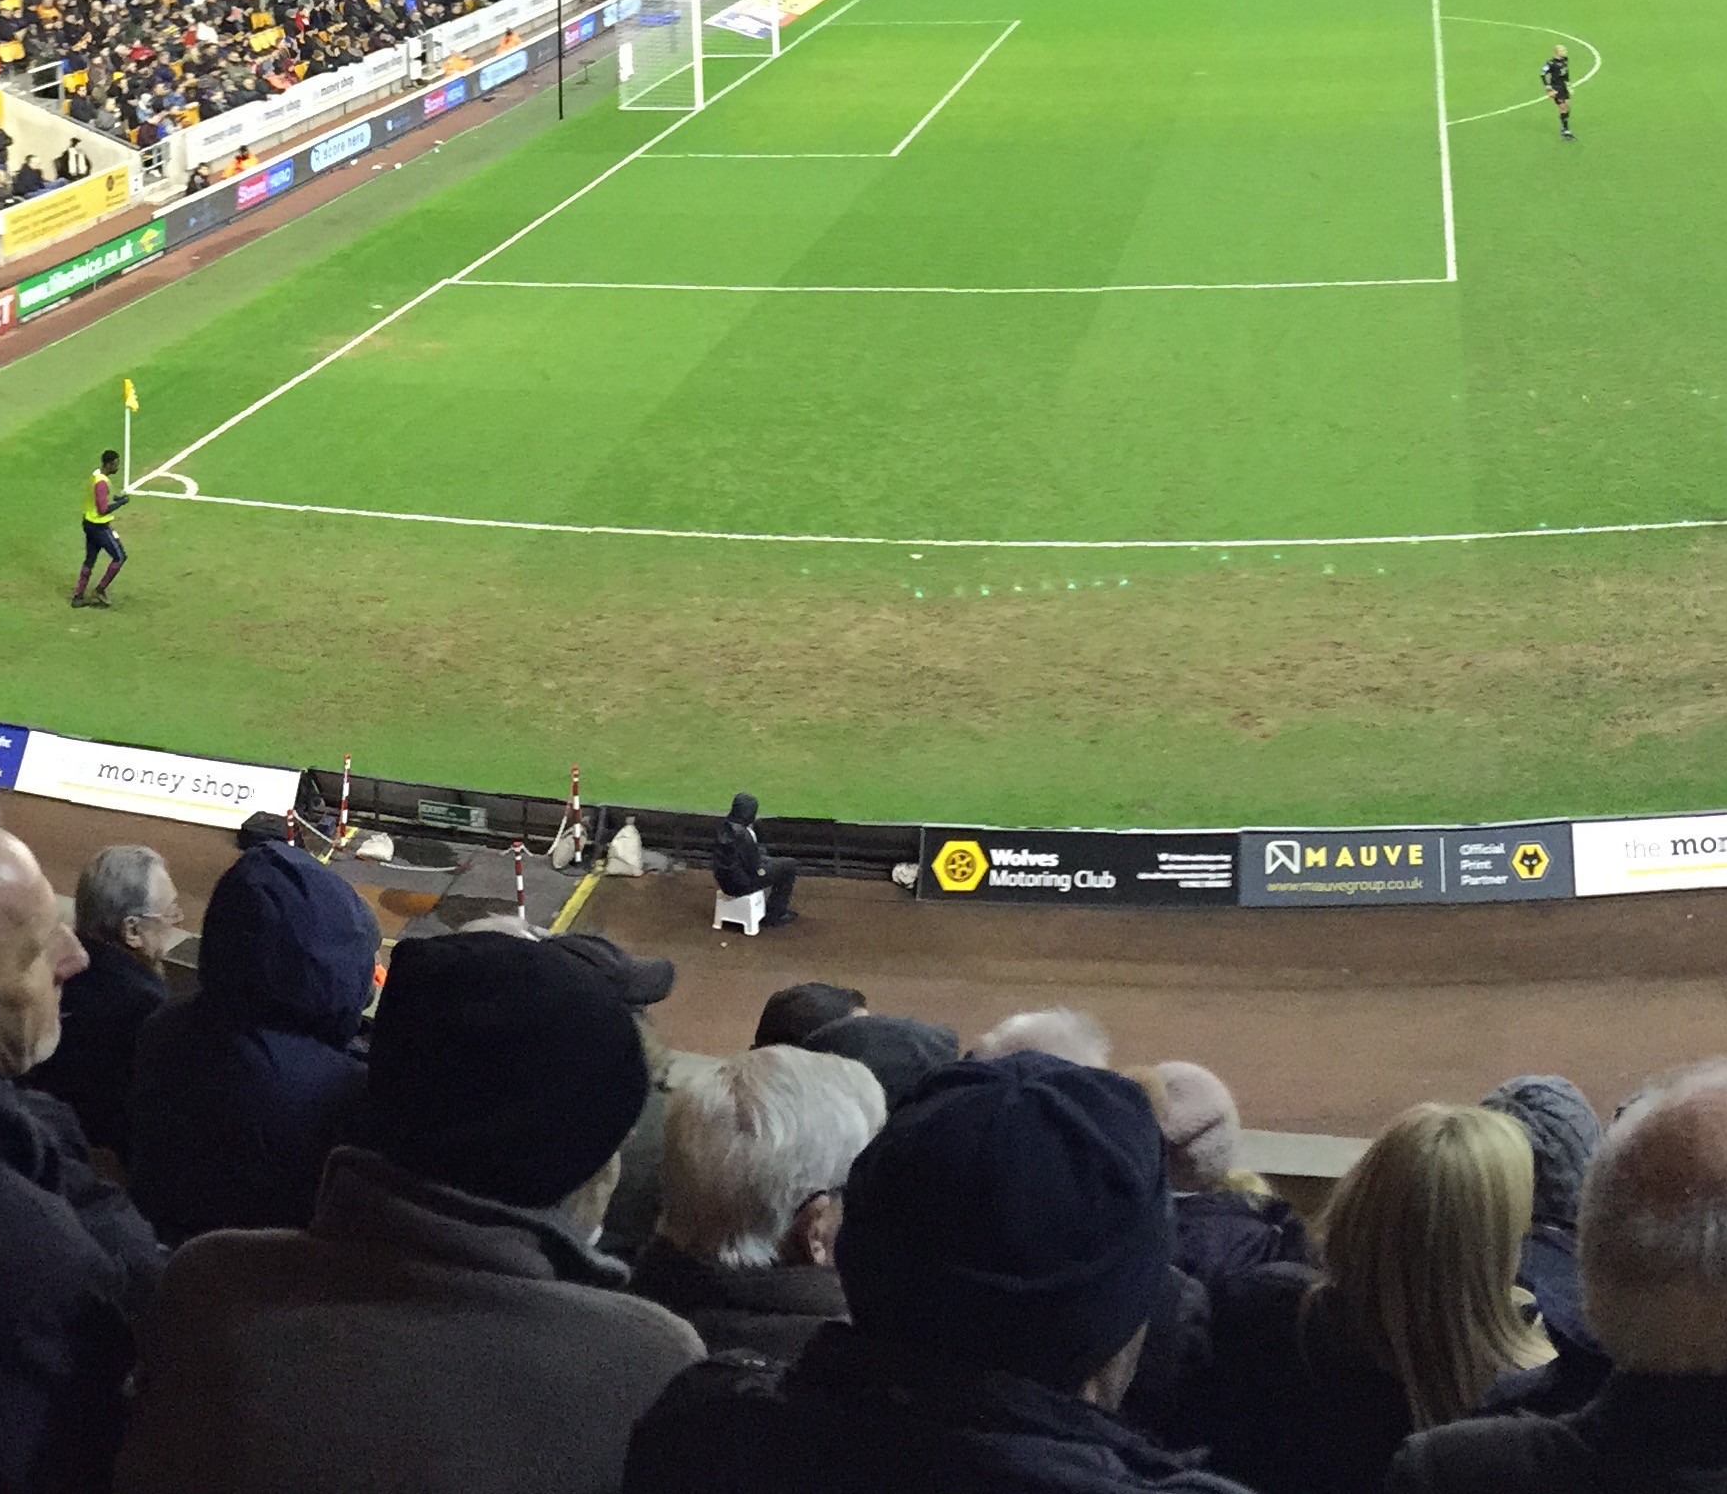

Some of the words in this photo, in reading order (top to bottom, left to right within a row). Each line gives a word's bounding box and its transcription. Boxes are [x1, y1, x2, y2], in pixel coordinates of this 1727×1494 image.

[97, 759, 186, 796] money
[191, 772, 256, 804] shop
[989, 848, 1060, 867] Wolves
[1304, 844, 1424, 868] MAUVE
[1459, 842, 1505, 855] Official
[1624, 837, 1663, 861] the
[1459, 859, 1493, 871] Print
[988, 870, 1072, 893] Motoring
[1074, 869, 1117, 889] Club
[1459, 874, 1509, 886] Partner
